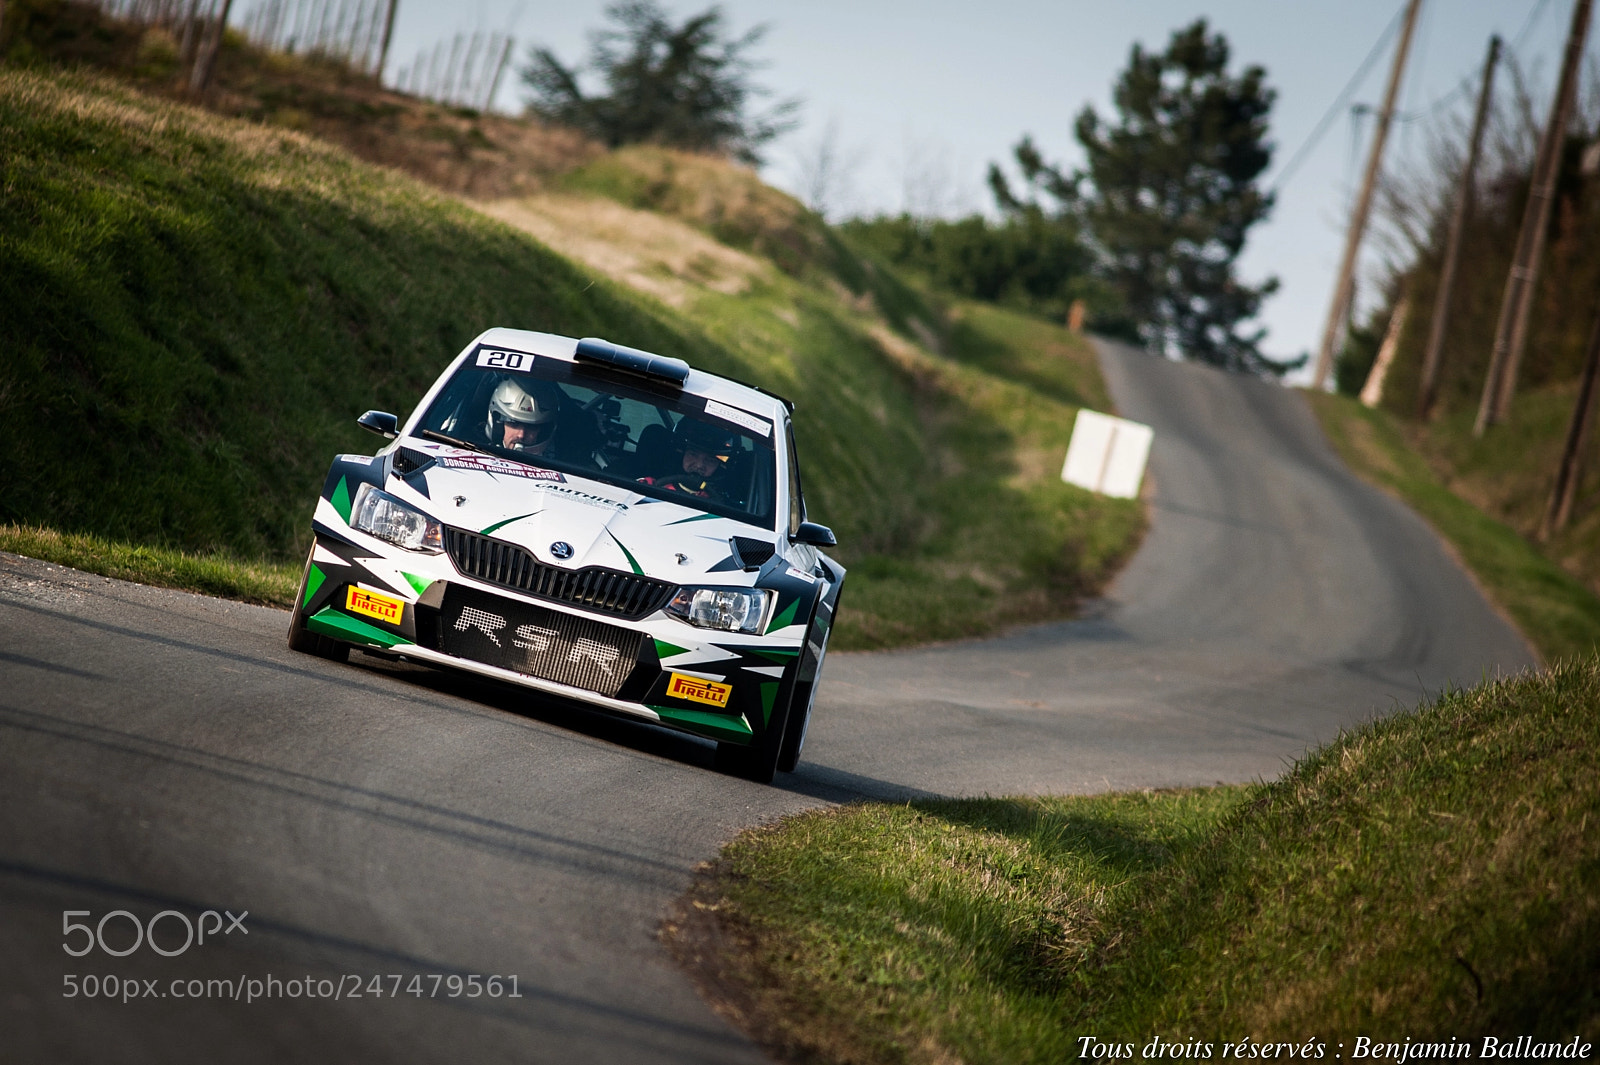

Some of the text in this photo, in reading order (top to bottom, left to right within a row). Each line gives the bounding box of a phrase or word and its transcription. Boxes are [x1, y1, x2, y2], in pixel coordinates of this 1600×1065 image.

[487, 351, 524, 368] 20
[443, 457, 485, 470] BORDEAUX
[486, 465, 526, 477] AQUITAINE
[527, 471, 560, 481] CLASSIC
[351, 591, 398, 618] PIRELLI
[673, 678, 726, 703] PIRELLI
